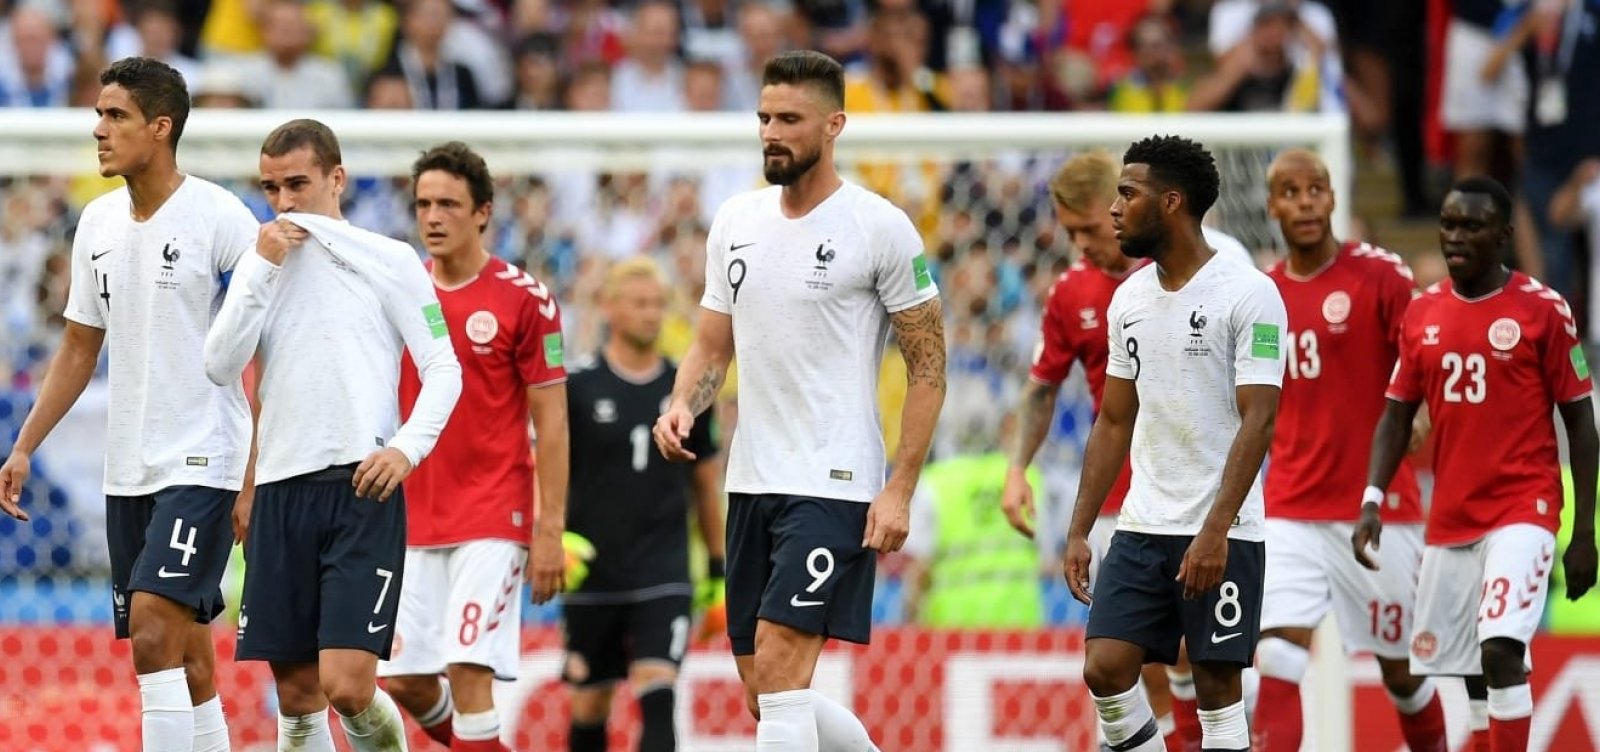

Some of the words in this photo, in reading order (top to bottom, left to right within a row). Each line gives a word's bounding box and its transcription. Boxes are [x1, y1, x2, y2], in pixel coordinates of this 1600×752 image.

[728, 259, 746, 304] 9
[1287, 330, 1321, 379] 13
[1442, 352, 1486, 403] 23
[630, 424, 649, 472] 1
[170, 518, 197, 566] 4
[374, 568, 393, 614] 7
[805, 547, 834, 593] 9
[459, 602, 481, 646] 8
[1214, 581, 1241, 627] 8
[1368, 600, 1402, 644] 13
[669, 615, 690, 660] 1
